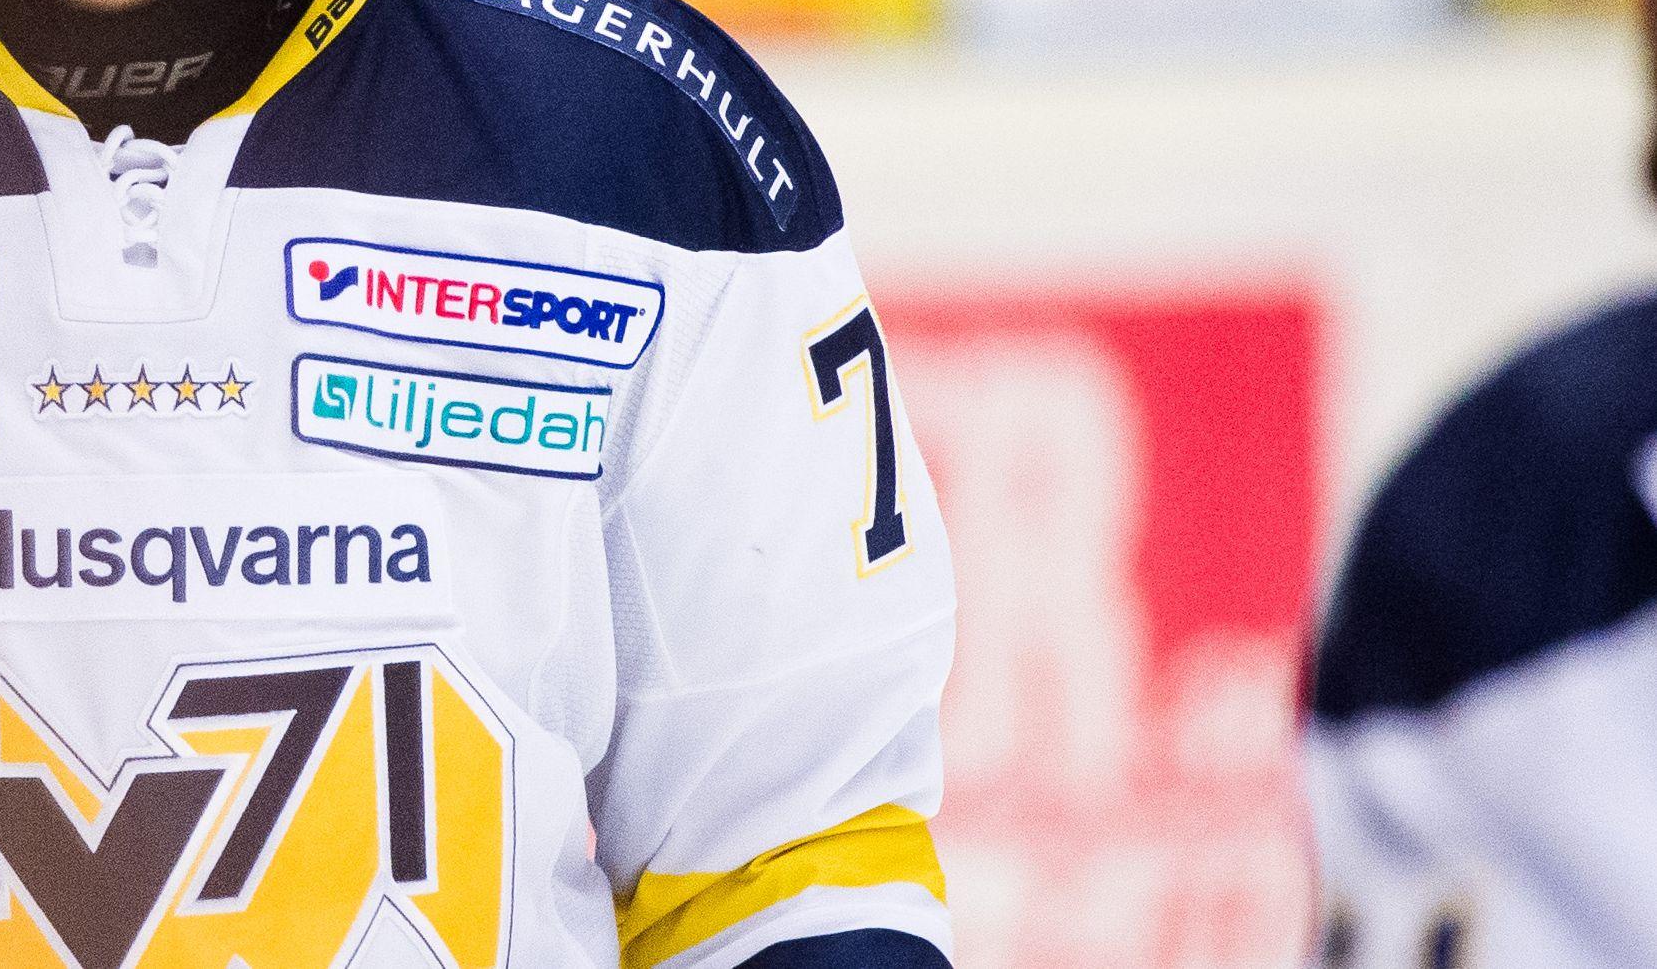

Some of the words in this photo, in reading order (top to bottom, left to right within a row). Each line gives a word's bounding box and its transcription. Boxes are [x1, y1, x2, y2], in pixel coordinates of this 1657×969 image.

[366, 268, 638, 344] INTERSPORT
[366, 375, 605, 452] Liljedah
[803, 298, 911, 572] 7
